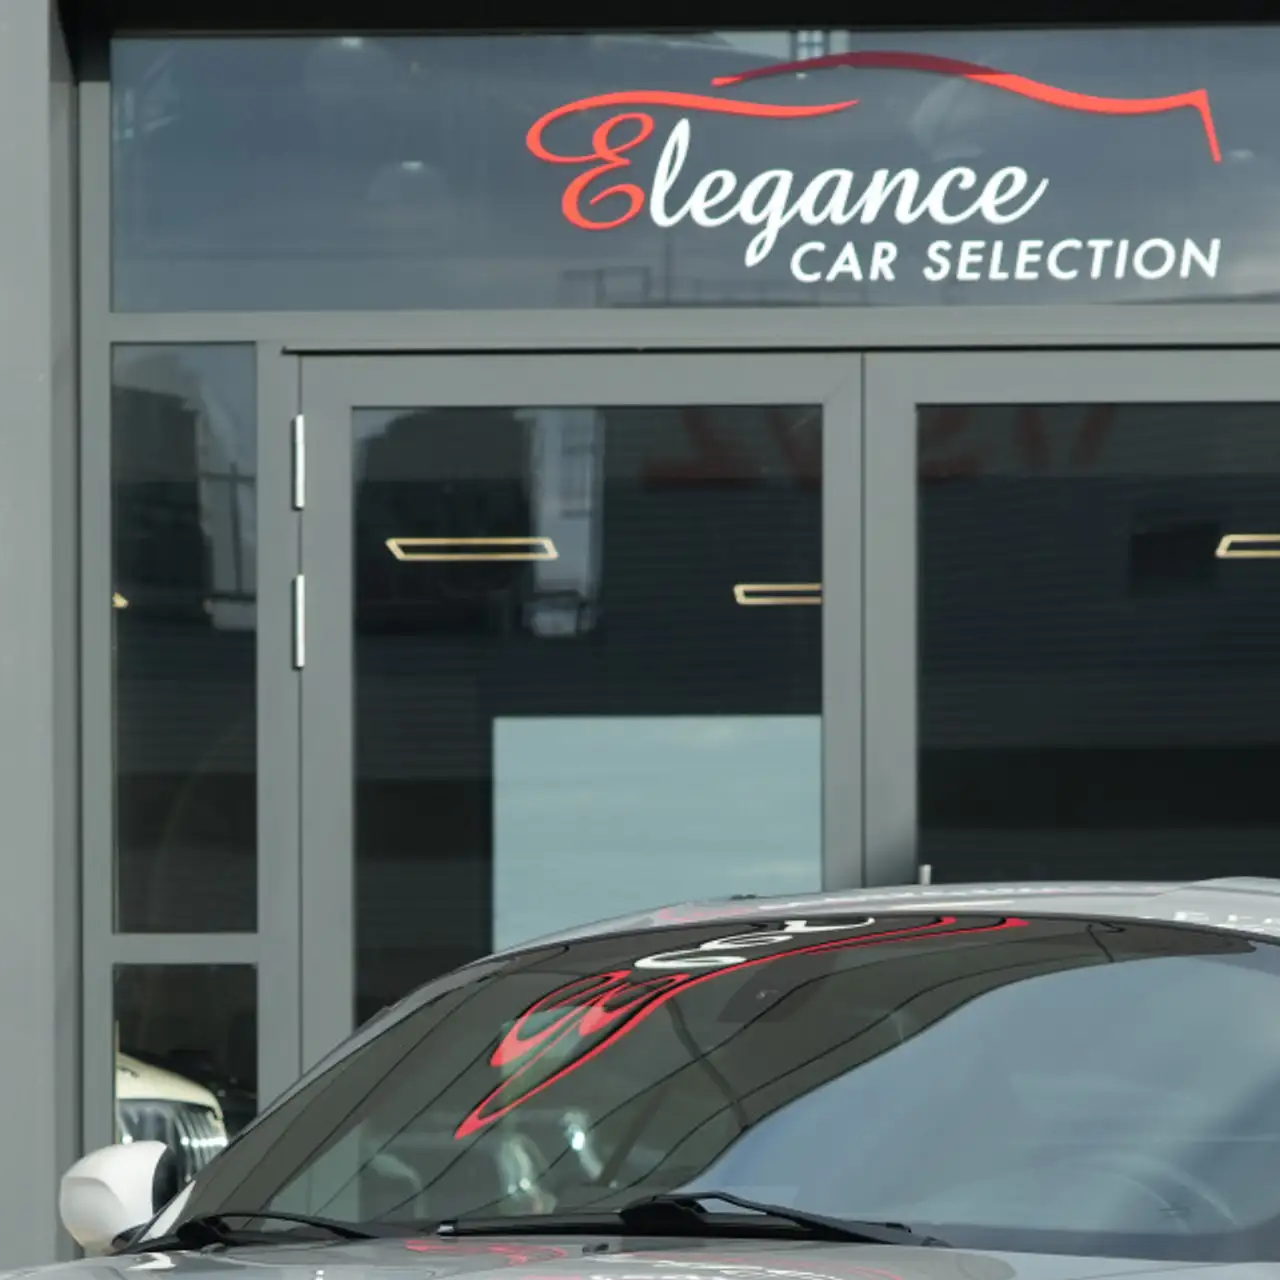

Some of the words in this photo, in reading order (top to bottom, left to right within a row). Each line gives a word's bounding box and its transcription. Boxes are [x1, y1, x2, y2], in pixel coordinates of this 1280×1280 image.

[526, 90, 1049, 268] Elegance
[790, 241, 898, 283] CAR
[922, 238, 1221, 282] SELECTION
